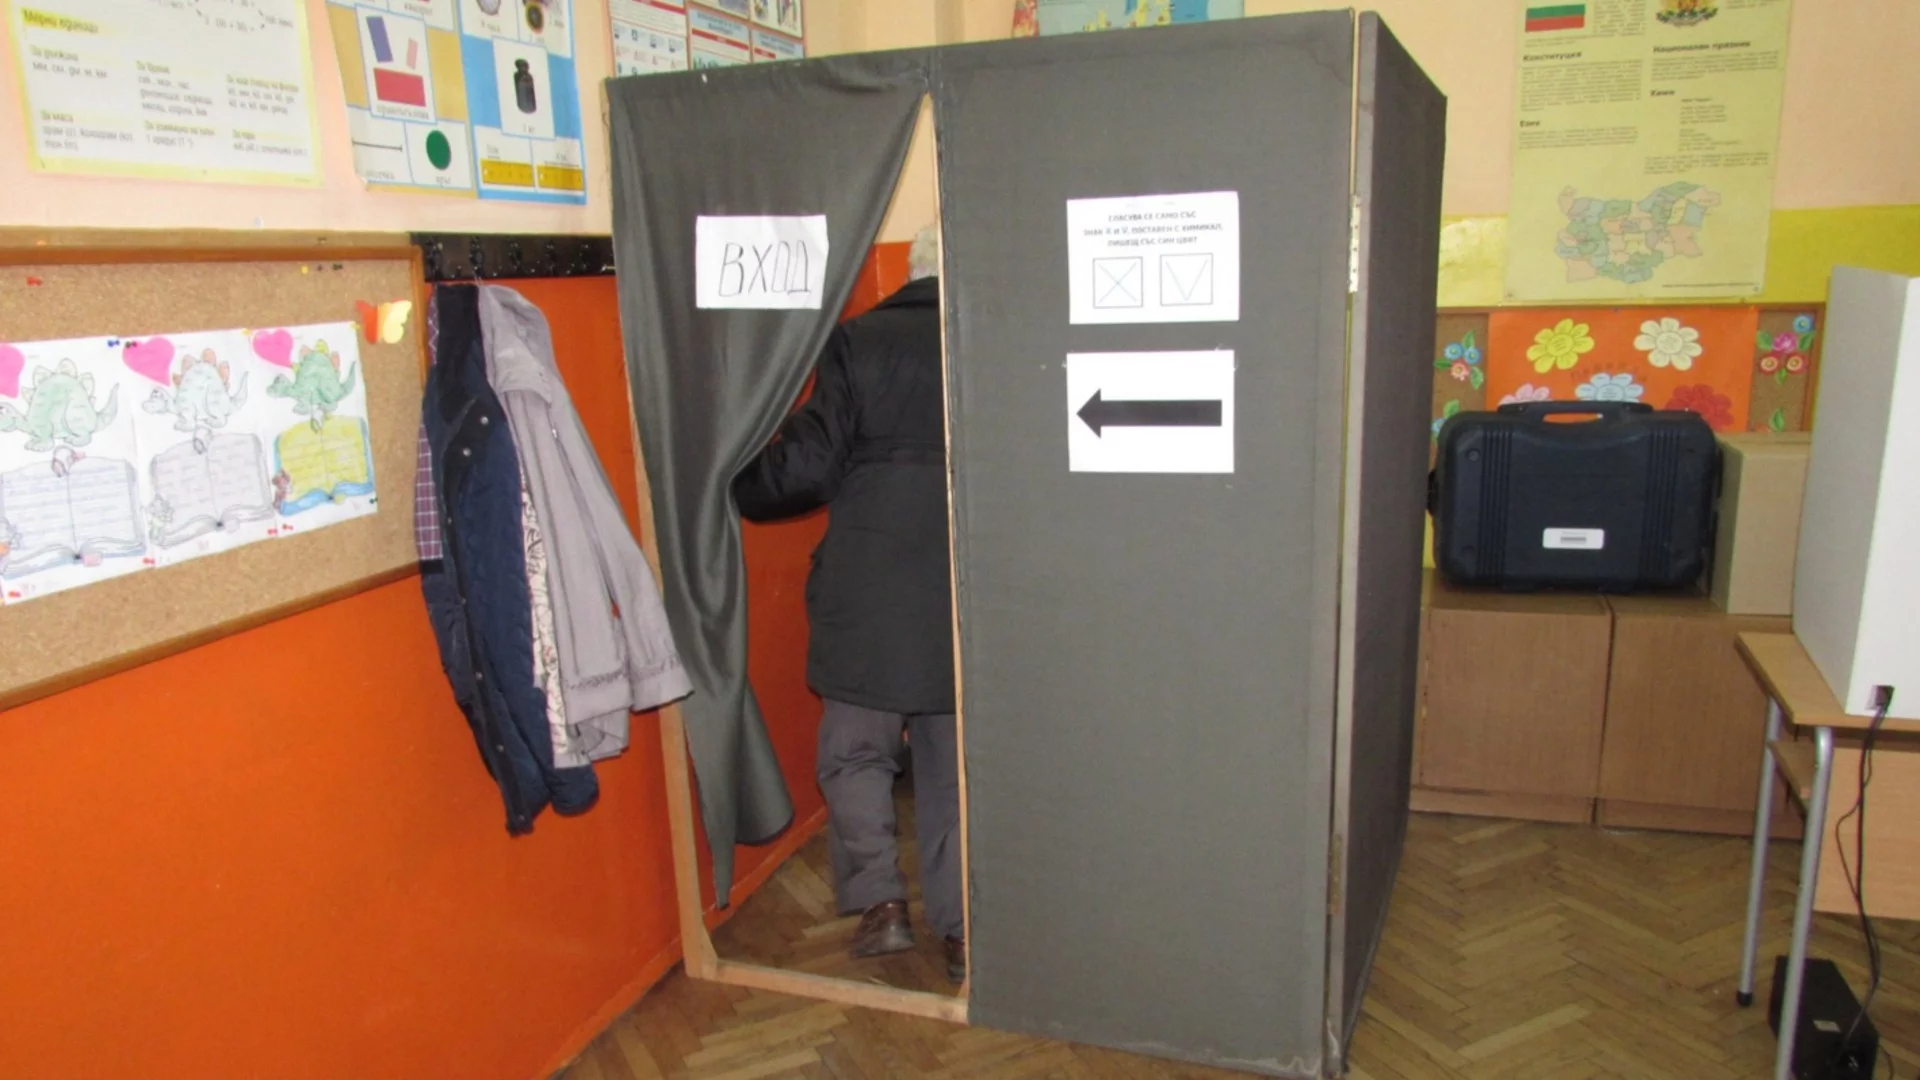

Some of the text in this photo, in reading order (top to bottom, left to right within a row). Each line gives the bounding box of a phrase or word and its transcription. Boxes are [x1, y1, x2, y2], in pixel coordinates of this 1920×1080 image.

[1107, 213, 1142, 223] ГЛАСУВА
[1143, 212, 1153, 221] СЕ
[1155, 210, 1179, 220] САМО
[1132, 224, 1173, 235] ПОСТАВЕН
[719, 240, 811, 298] ВХОД
